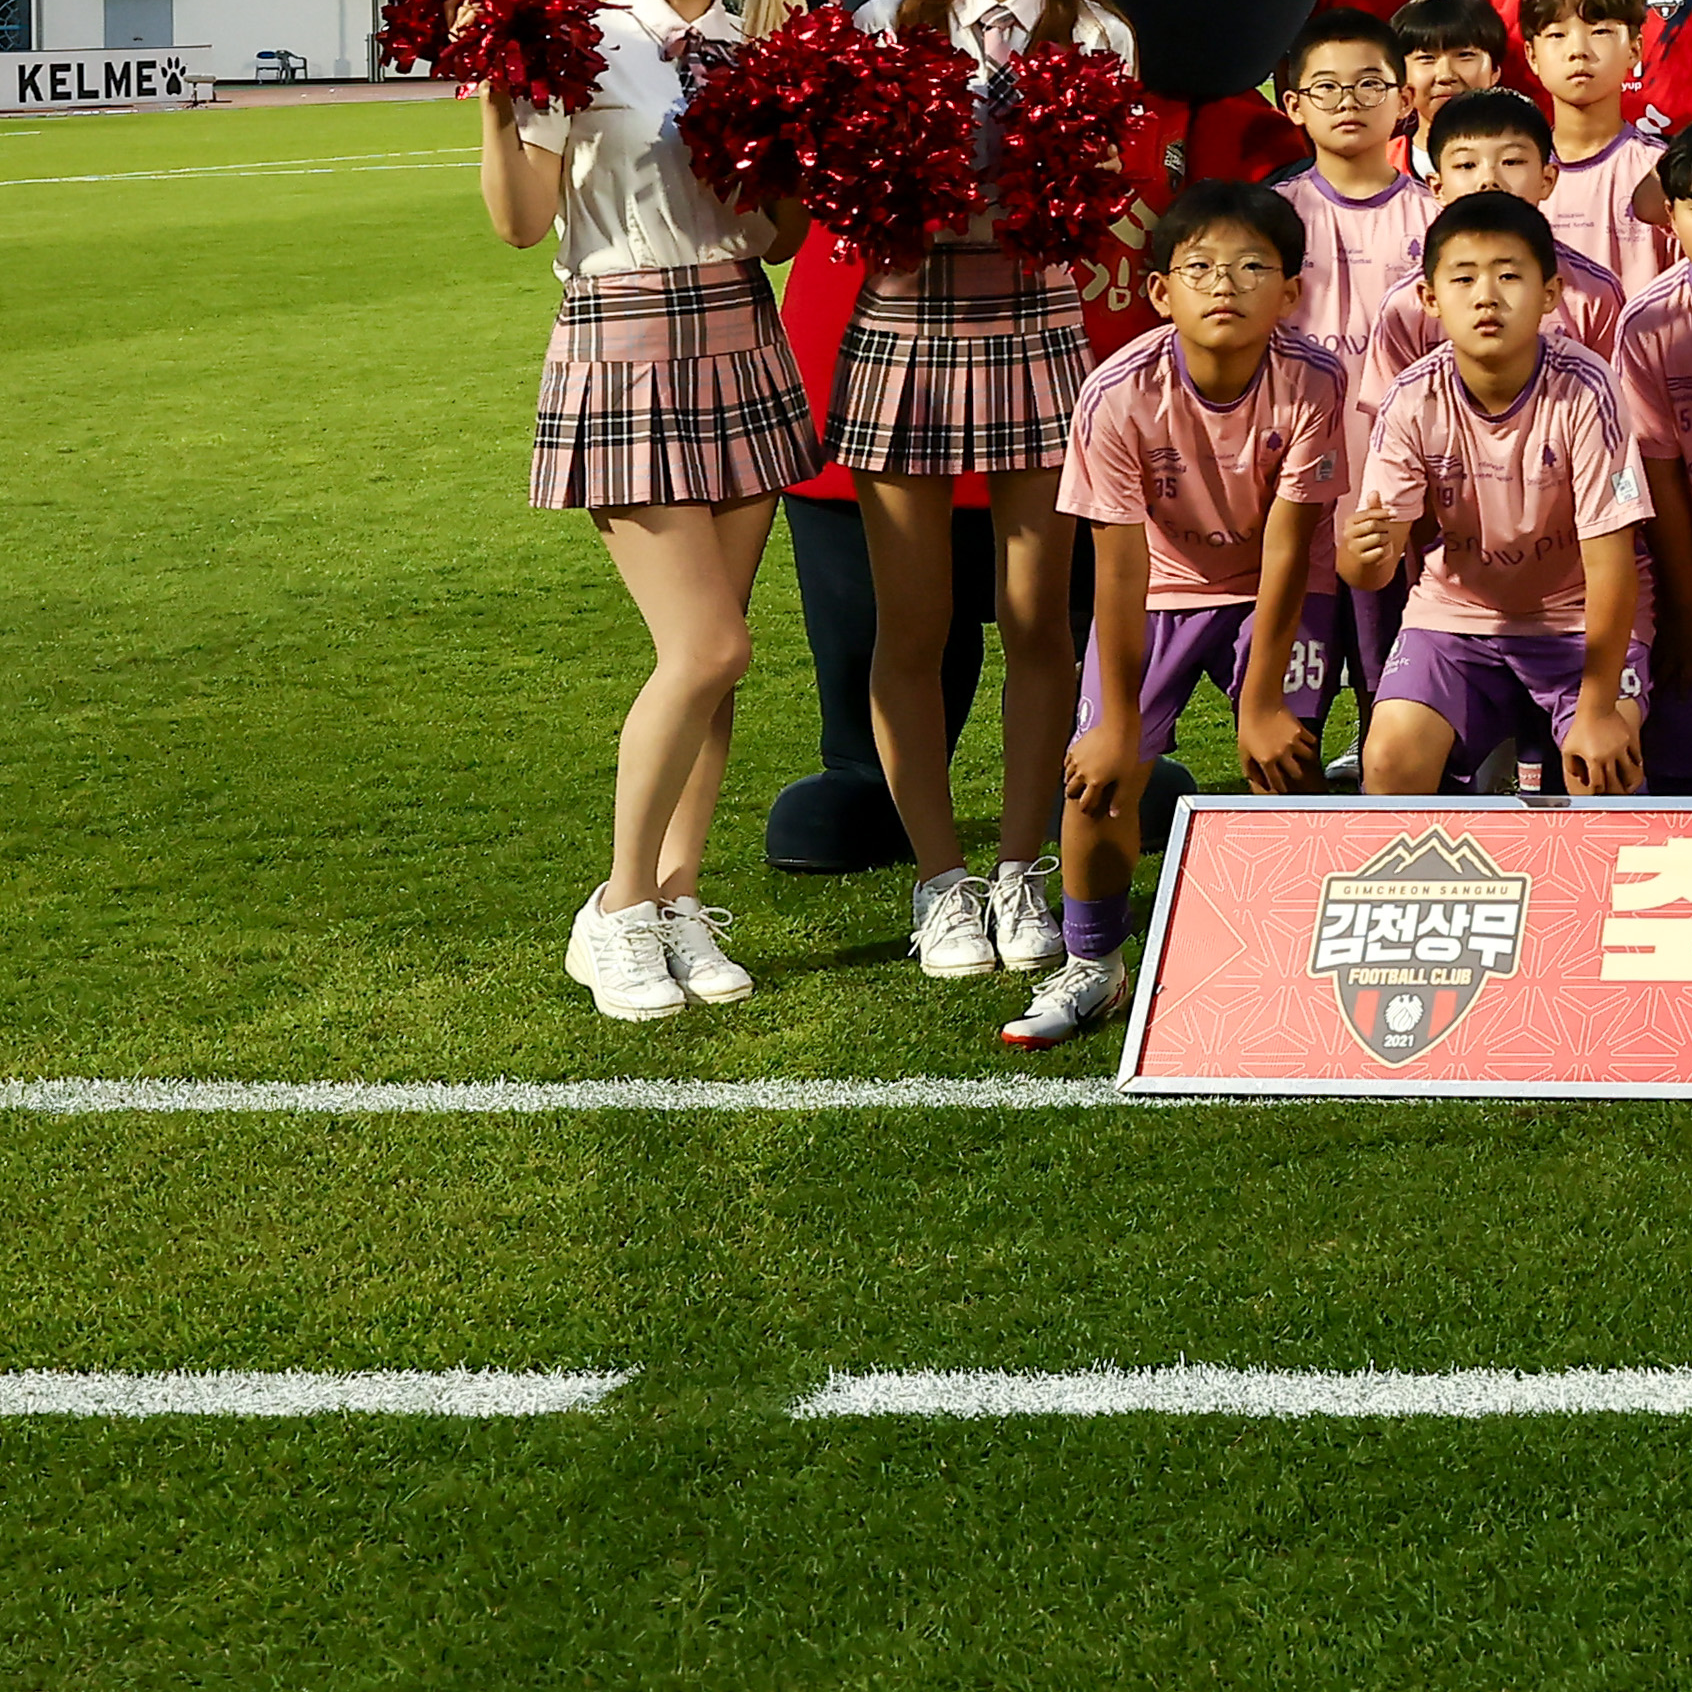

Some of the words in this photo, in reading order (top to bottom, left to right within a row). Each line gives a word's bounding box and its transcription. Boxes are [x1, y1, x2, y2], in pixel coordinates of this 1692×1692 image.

[17, 61, 158, 104] KELME
[1283, 639, 1326, 695] 35
[1343, 885, 1430, 896] GIMCHEON
[1440, 885, 1509, 896] SANGMU
[1315, 903, 1520, 970] 김천상무
[1348, 968, 1428, 985] FOOTBALL
[1430, 968, 1473, 985] CLUB
[1383, 1034, 1415, 1048] 2021
